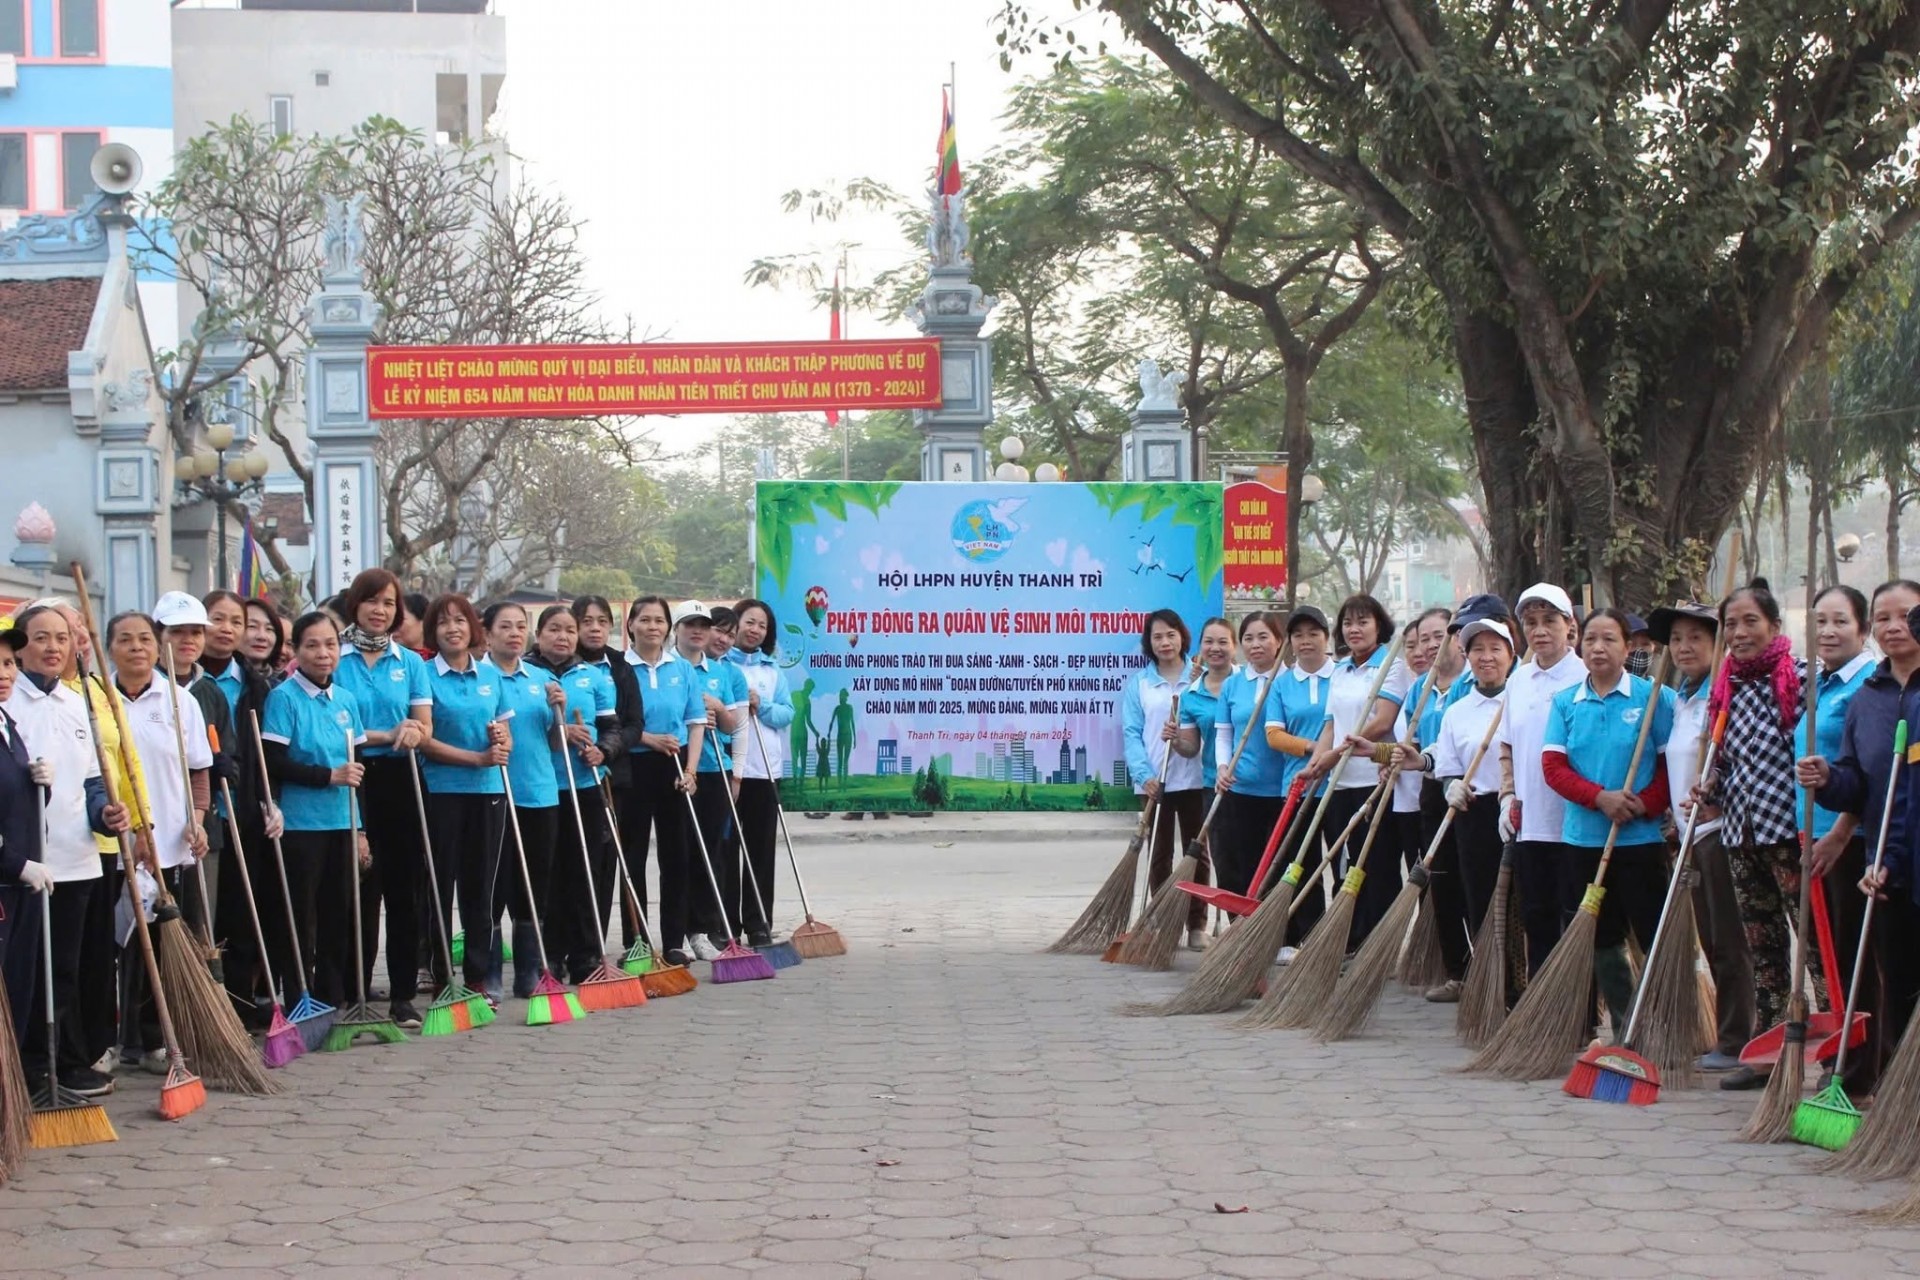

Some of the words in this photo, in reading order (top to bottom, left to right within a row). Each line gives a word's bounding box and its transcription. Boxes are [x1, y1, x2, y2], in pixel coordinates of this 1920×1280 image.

[384, 359, 423, 381] NHIỆT
[427, 359, 454, 381] LIỆT
[458, 358, 493, 377] CHÀO
[498, 357, 538, 376] MỪNG
[542, 356, 567, 376] QUÝ
[572, 359, 585, 379] VỊ
[589, 359, 610, 379] ĐẠI
[615, 353, 649, 376] BIỂU,
[653, 355, 690, 374] NHÂN
[694, 354, 721, 374] DÂN
[725, 354, 742, 373] VÀ
[746, 352, 789, 372] KHÁCH
[793, 353, 826, 375] THẬP
[831, 353, 884, 371] PHƯƠNG
[888, 349, 903, 369] VỀ
[907, 353, 926, 372] DỰ
[385, 384, 400, 405] LỄ
[404, 383, 421, 405] KỶ
[425, 385, 460, 408] NIỆM
[464, 387, 488, 404] 654
[492, 384, 524, 403] NĂM
[528, 384, 564, 403] NGÀY
[599, 386, 634, 402] DANH
[639, 382, 675, 401] NHÂN
[680, 382, 708, 400] TIÊN
[712, 379, 748, 399] TRIẾT
[752, 381, 778, 398] CHU
[782, 380, 808, 397] VĂN
[812, 381, 831, 397] AN
[835, 381, 871, 398] (1370
[884, 380, 926, 397] 2024)!
[878, 570, 908, 591] HỘI
[914, 573, 955, 587] LHPN
[960, 570, 1013, 590] HUYỆN
[1018, 573, 1074, 587] THANH
[1079, 570, 1102, 587] TRÌ
[827, 608, 868, 633] PHÁT
[872, 608, 913, 637] ĐỘNG
[918, 612, 939, 633] RA
[944, 608, 986, 636] QUÂN
[991, 608, 1010, 637] VỆ
[1014, 612, 1051, 634] SINH
[1056, 608, 1085, 633] MÔI
[810, 650, 842, 668] HƯỚNG
[845, 650, 864, 668] ỨNG
[867, 655, 899, 668] PHONG
[902, 651, 925, 668] TRÀO
[929, 655, 943, 668] THI
[946, 655, 964, 668] ĐUA
[966, 651, 992, 668] SÁNG
[1033, 655, 1059, 671] SẠCH
[1068, 655, 1086, 671] ĐẸP
[1088, 652, 1119, 671] HUYỆN
[853, 675, 870, 691] XÂY
[874, 677, 900, 694] DỰNG
[902, 675, 917, 691] MÔ
[920, 675, 943, 691] HÌNH
[979, 673, 1044, 691] ĐƯỜNG/TUYẾN
[1046, 674, 1065, 691] PHỐ
[1068, 675, 1100, 691] KHÔNG
[866, 698, 891, 714] CHÀO
[893, 698, 915, 714] NĂM
[918, 698, 937, 714] MỚI
[967, 698, 996, 714] MỪNG
[1030, 698, 1058, 714] MỪNG
[1061, 698, 1086, 714] XUÂN
[1089, 697, 1100, 714] ẤT
[1103, 701, 1114, 717] TỴ
[908, 730, 935, 740] Thanh
[953, 730, 975, 742] ngày
[977, 730, 988, 740] 04
[1030, 730, 1049, 740] năm
[1052, 730, 1072, 740] 2025
